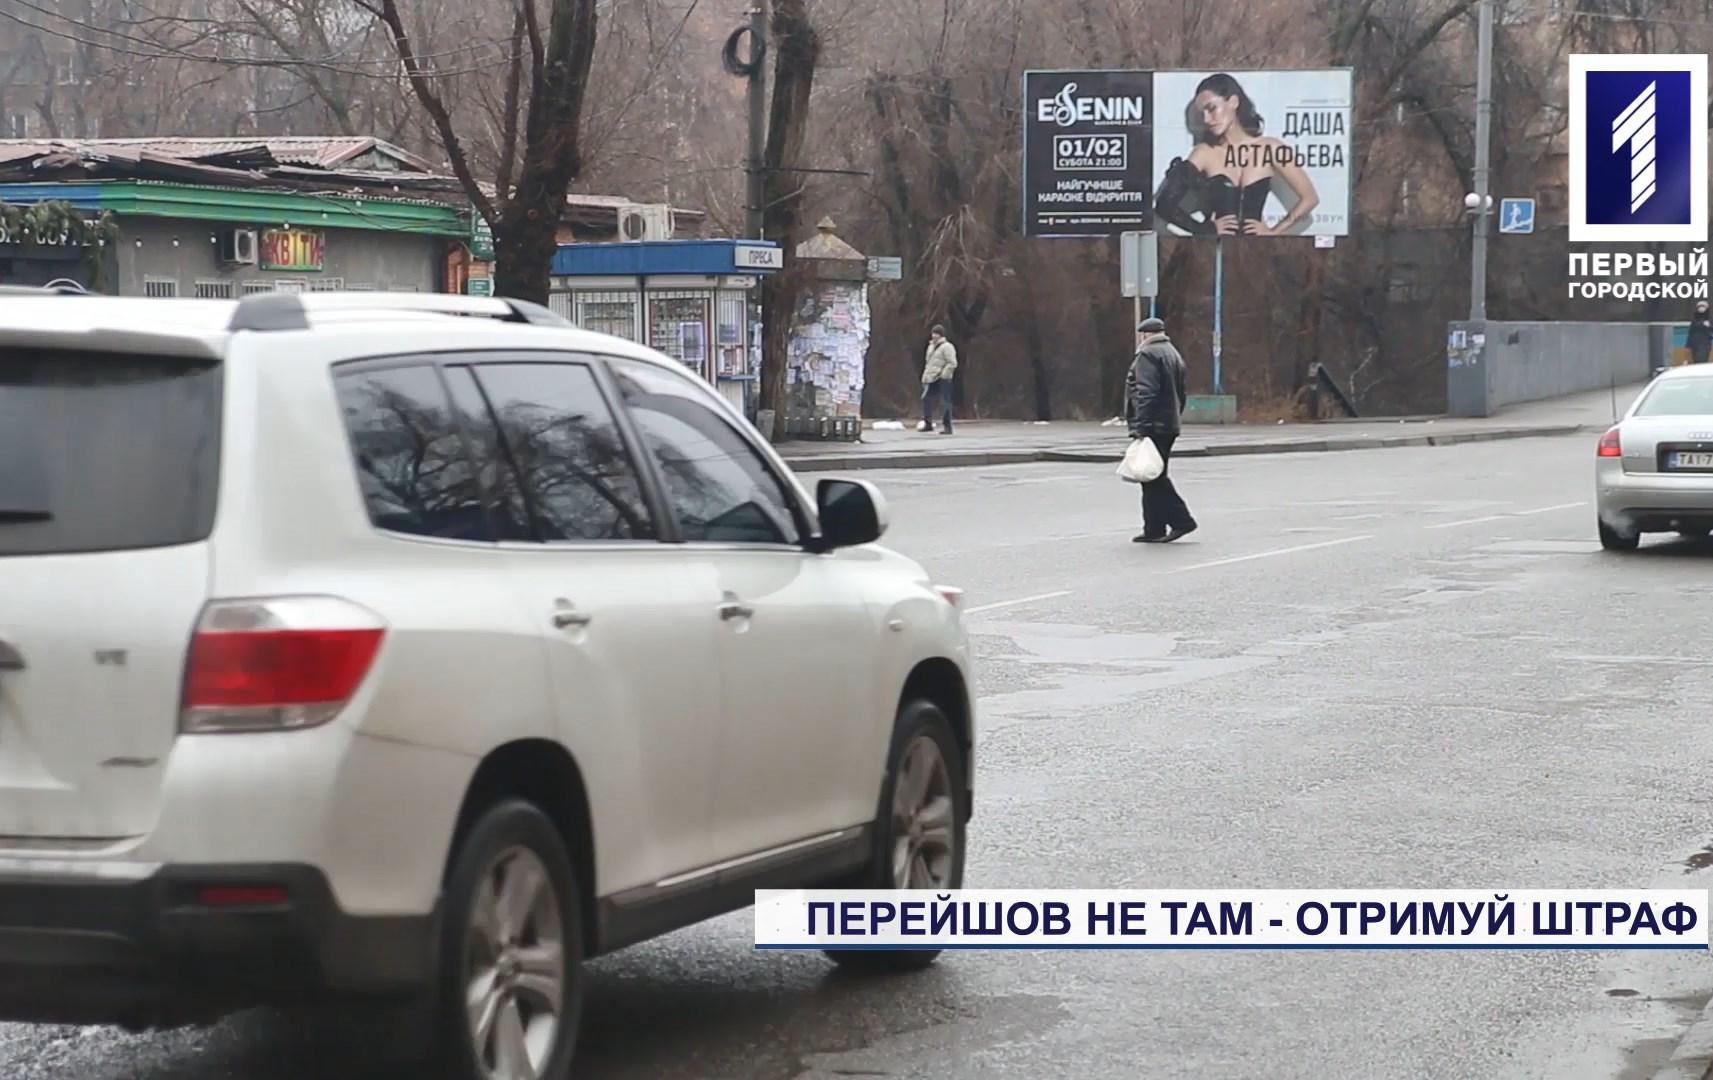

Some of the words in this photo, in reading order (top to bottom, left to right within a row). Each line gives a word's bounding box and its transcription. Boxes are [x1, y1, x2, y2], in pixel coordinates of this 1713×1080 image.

[1037, 82, 1143, 127] ESENIN
[1282, 112, 1345, 138] ДАША
[1058, 138, 1122, 157] 01/02
[1224, 144, 1345, 168] АСТАФЬЕВА
[1058, 158, 1093, 167] СУБОТА
[1095, 158, 1122, 167] 21:00
[1056, 179, 1124, 191] НАЙГУЧНІШЕ
[1038, 192, 1084, 203] КАРАОКЕ
[1085, 192, 1142, 203] ВІДКРИТТЯ
[748, 250, 775, 266] ПРЕСА
